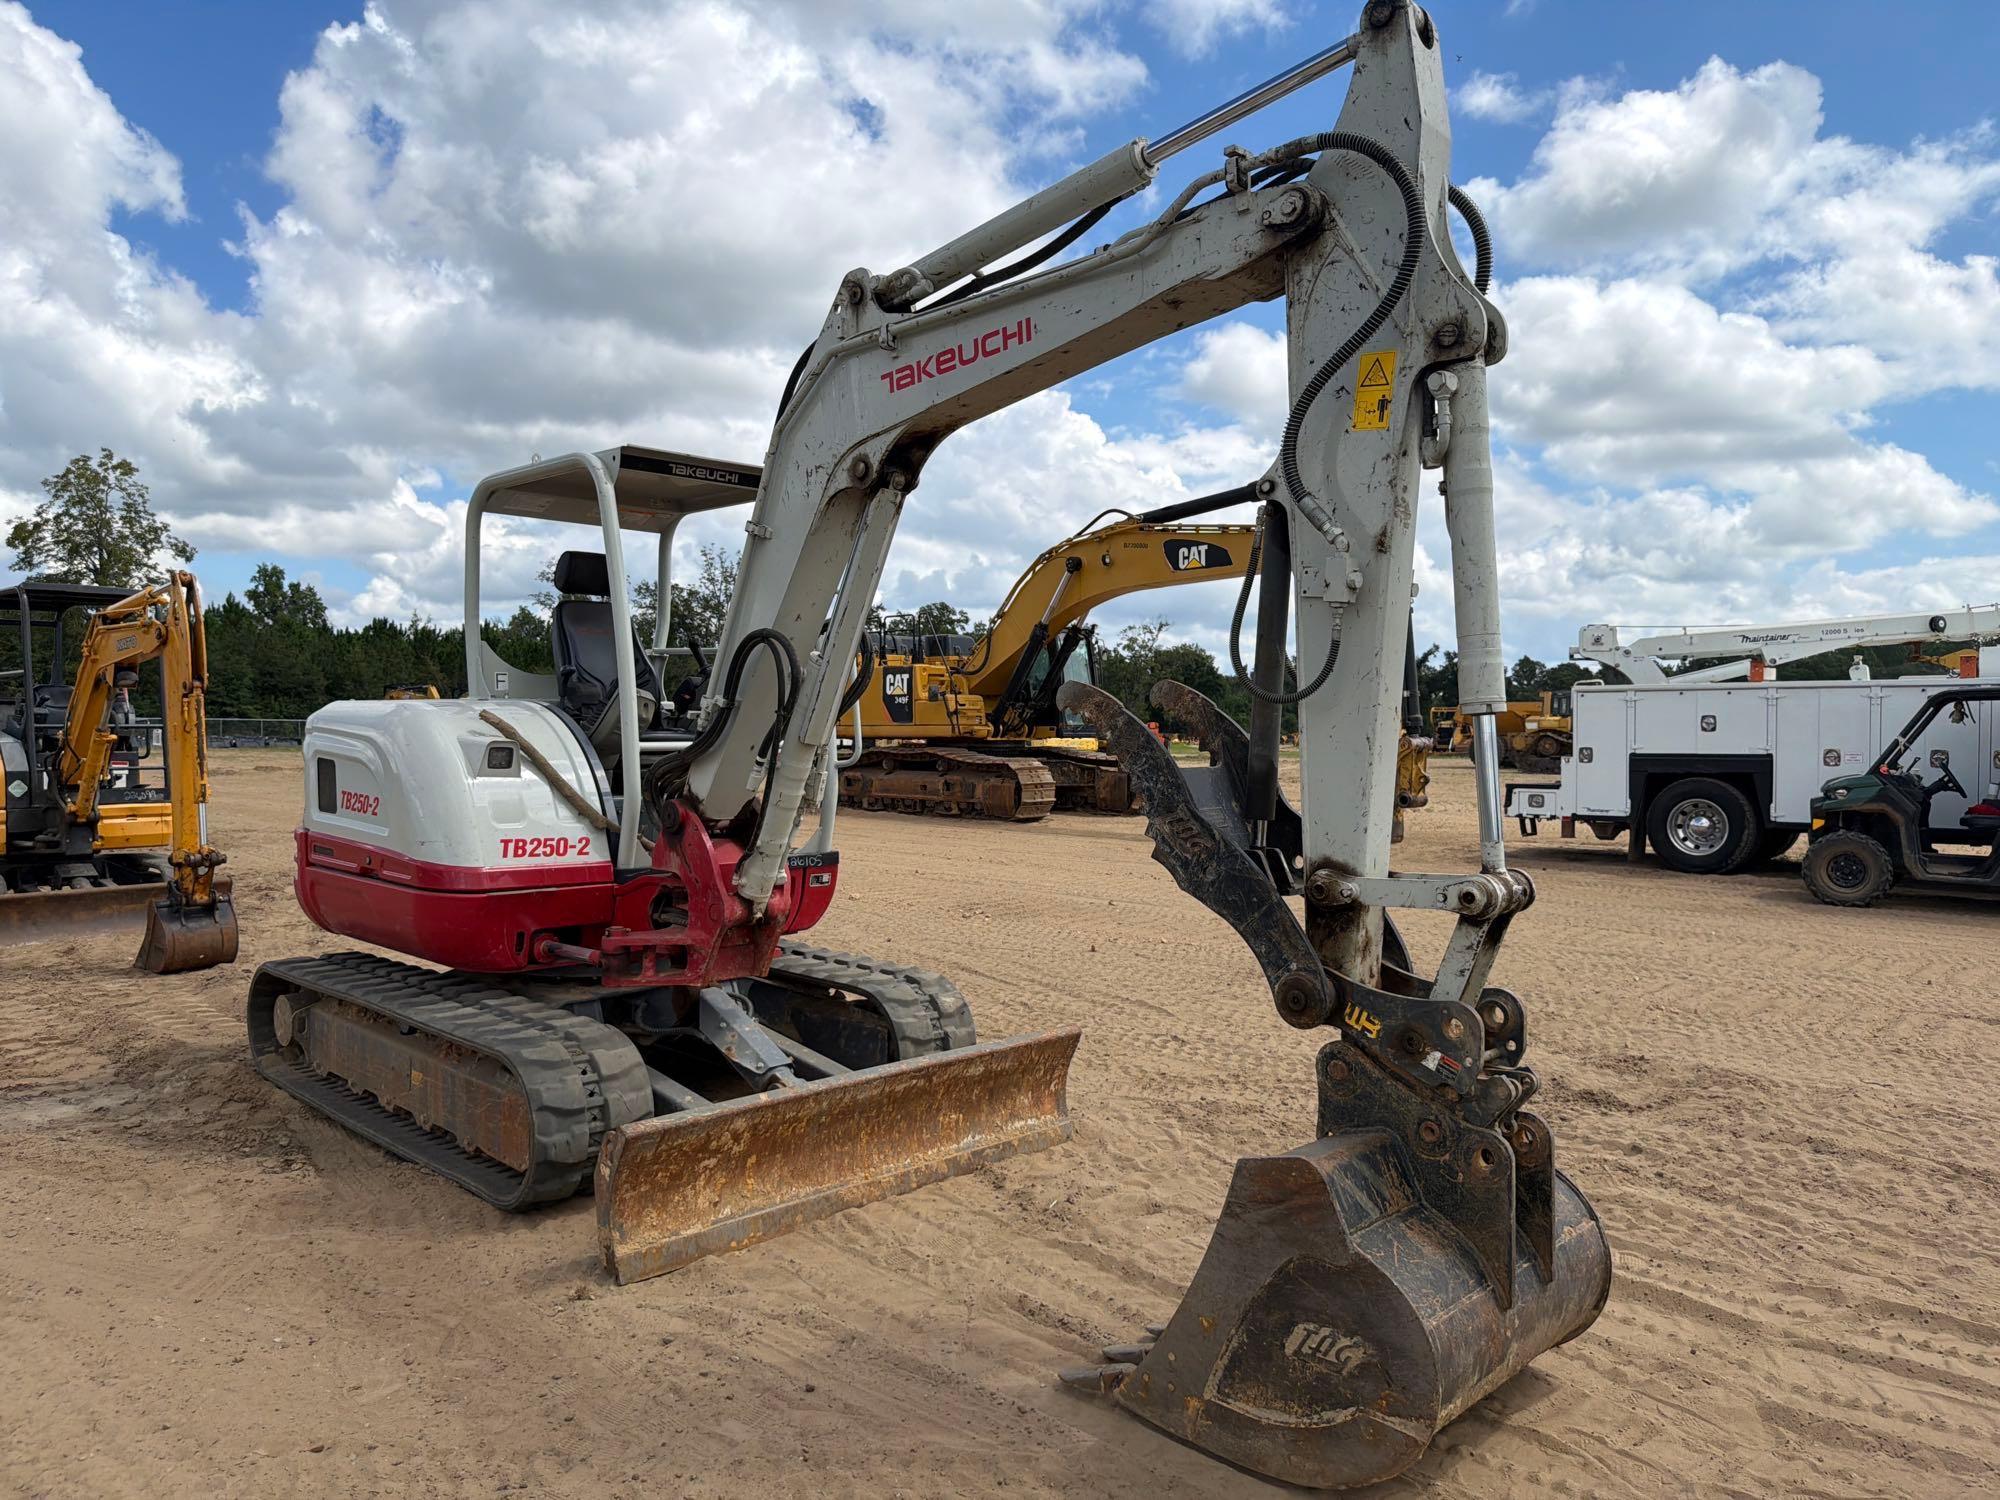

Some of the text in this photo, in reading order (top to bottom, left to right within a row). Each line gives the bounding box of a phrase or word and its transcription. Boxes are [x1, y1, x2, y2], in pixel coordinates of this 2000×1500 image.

[880, 317, 1033, 394] TAKEUCHI
[1178, 544, 1208, 570] CAT
[495, 672, 508, 690] F
[885, 673, 909, 695] CAT
[894, 695, 909, 704] 349F
[341, 790, 380, 816] TB250-2
[500, 836, 591, 859] TB250-2
